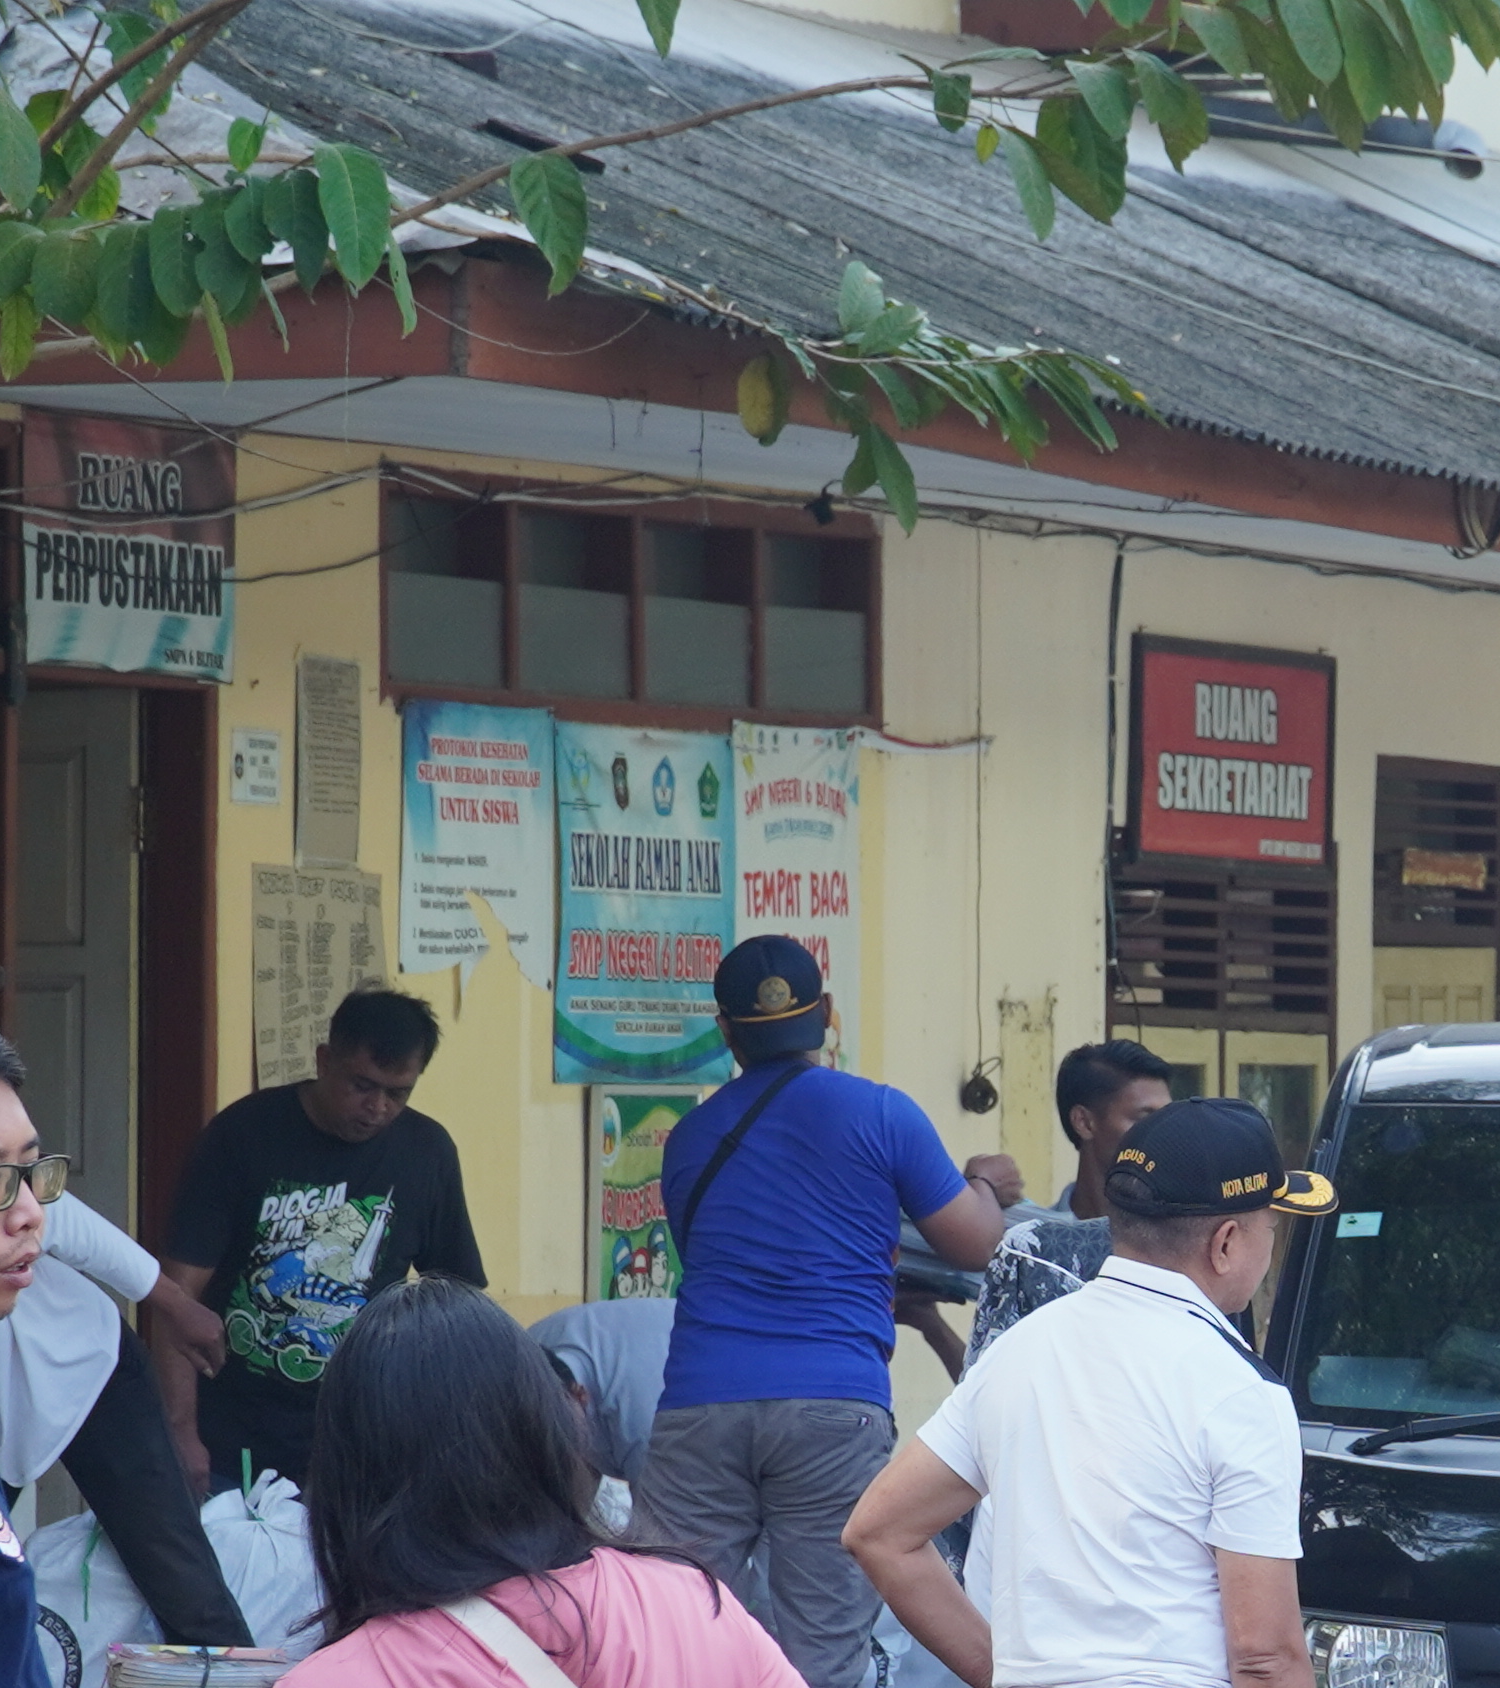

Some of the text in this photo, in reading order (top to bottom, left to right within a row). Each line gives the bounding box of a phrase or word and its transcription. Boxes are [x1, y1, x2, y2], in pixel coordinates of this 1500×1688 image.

[78, 452, 182, 515] RUANG
[35, 530, 224, 617] PERPUSTAKAAN
[1195, 682, 1278, 745] RUANG
[480, 741, 528, 760] KESEHATAN
[418, 763, 453, 782] SELAMA
[490, 769, 501, 785] DI
[502, 770, 541, 788] SEKOLAH
[745, 778, 847, 818] SMP NEGERI 6 BLITAR
[1157, 752, 1313, 820] SEKRETARIAT
[440, 797, 520, 825] UNTUK SISWA
[571, 831, 721, 894] SEKOLAH RAMAH ANAK
[743, 868, 849, 919] TEMPAT BACA
[454, 928, 478, 939] CUCI
[569, 930, 722, 983] SMP NEGERI 6 BLITAR
[1115, 1149, 1147, 1165] AGUS
[1221, 1172, 1269, 1199] KOTA BLITAR
